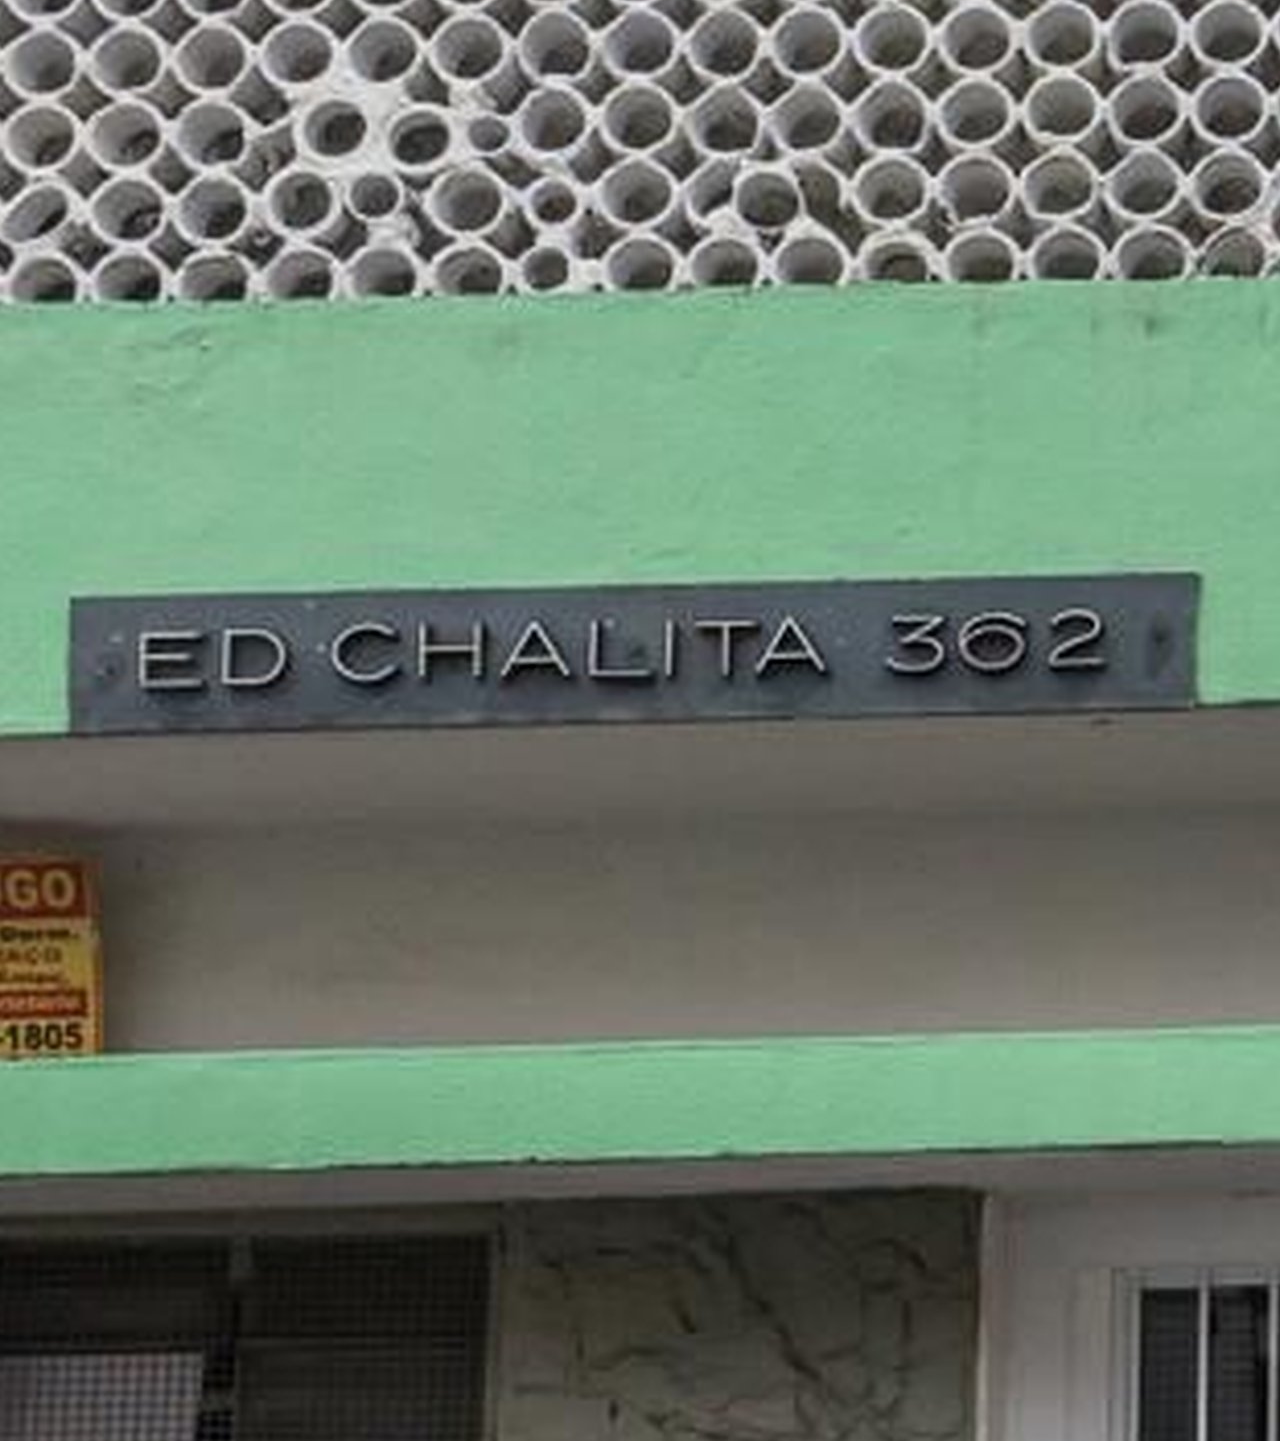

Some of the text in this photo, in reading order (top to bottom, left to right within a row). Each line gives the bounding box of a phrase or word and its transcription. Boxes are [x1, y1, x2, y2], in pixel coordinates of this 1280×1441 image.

[135, 606, 1107, 691] ED CHALITA 362
